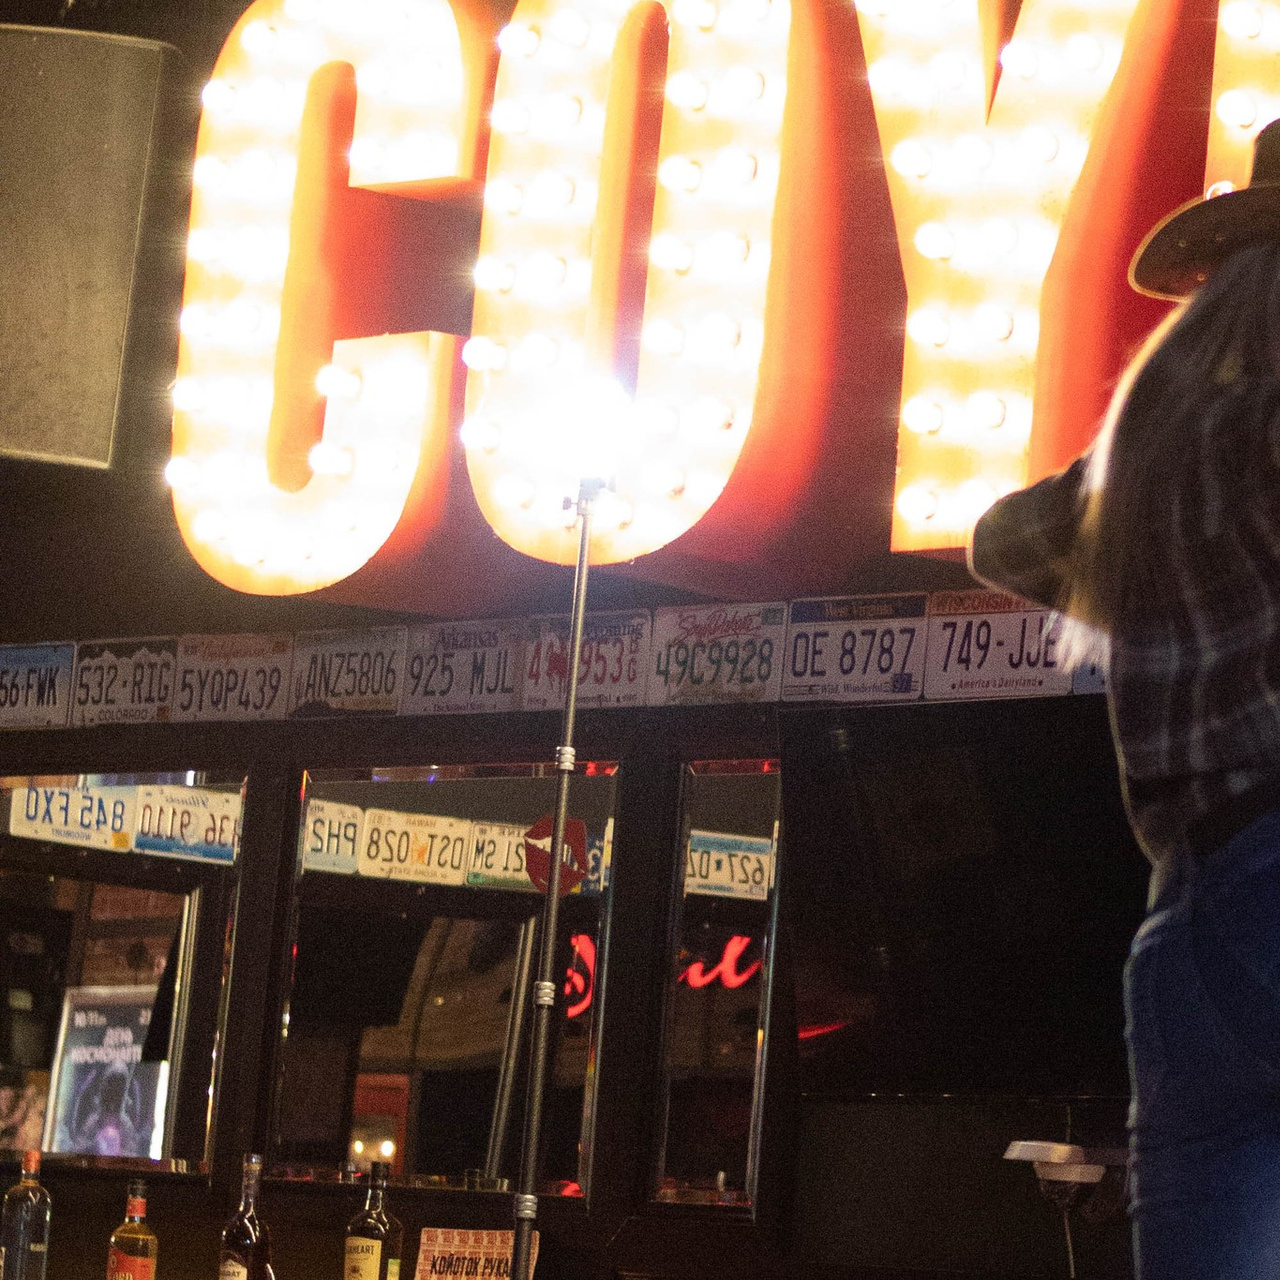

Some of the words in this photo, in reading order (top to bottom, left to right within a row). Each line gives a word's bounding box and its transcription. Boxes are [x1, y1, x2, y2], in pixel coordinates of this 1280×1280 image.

[436, 627, 499, 651] Arkansas
[839, 627, 917, 676] 8787
[410, 654, 456, 698] 925
[482, 1256, 511, 1278] РУКА
